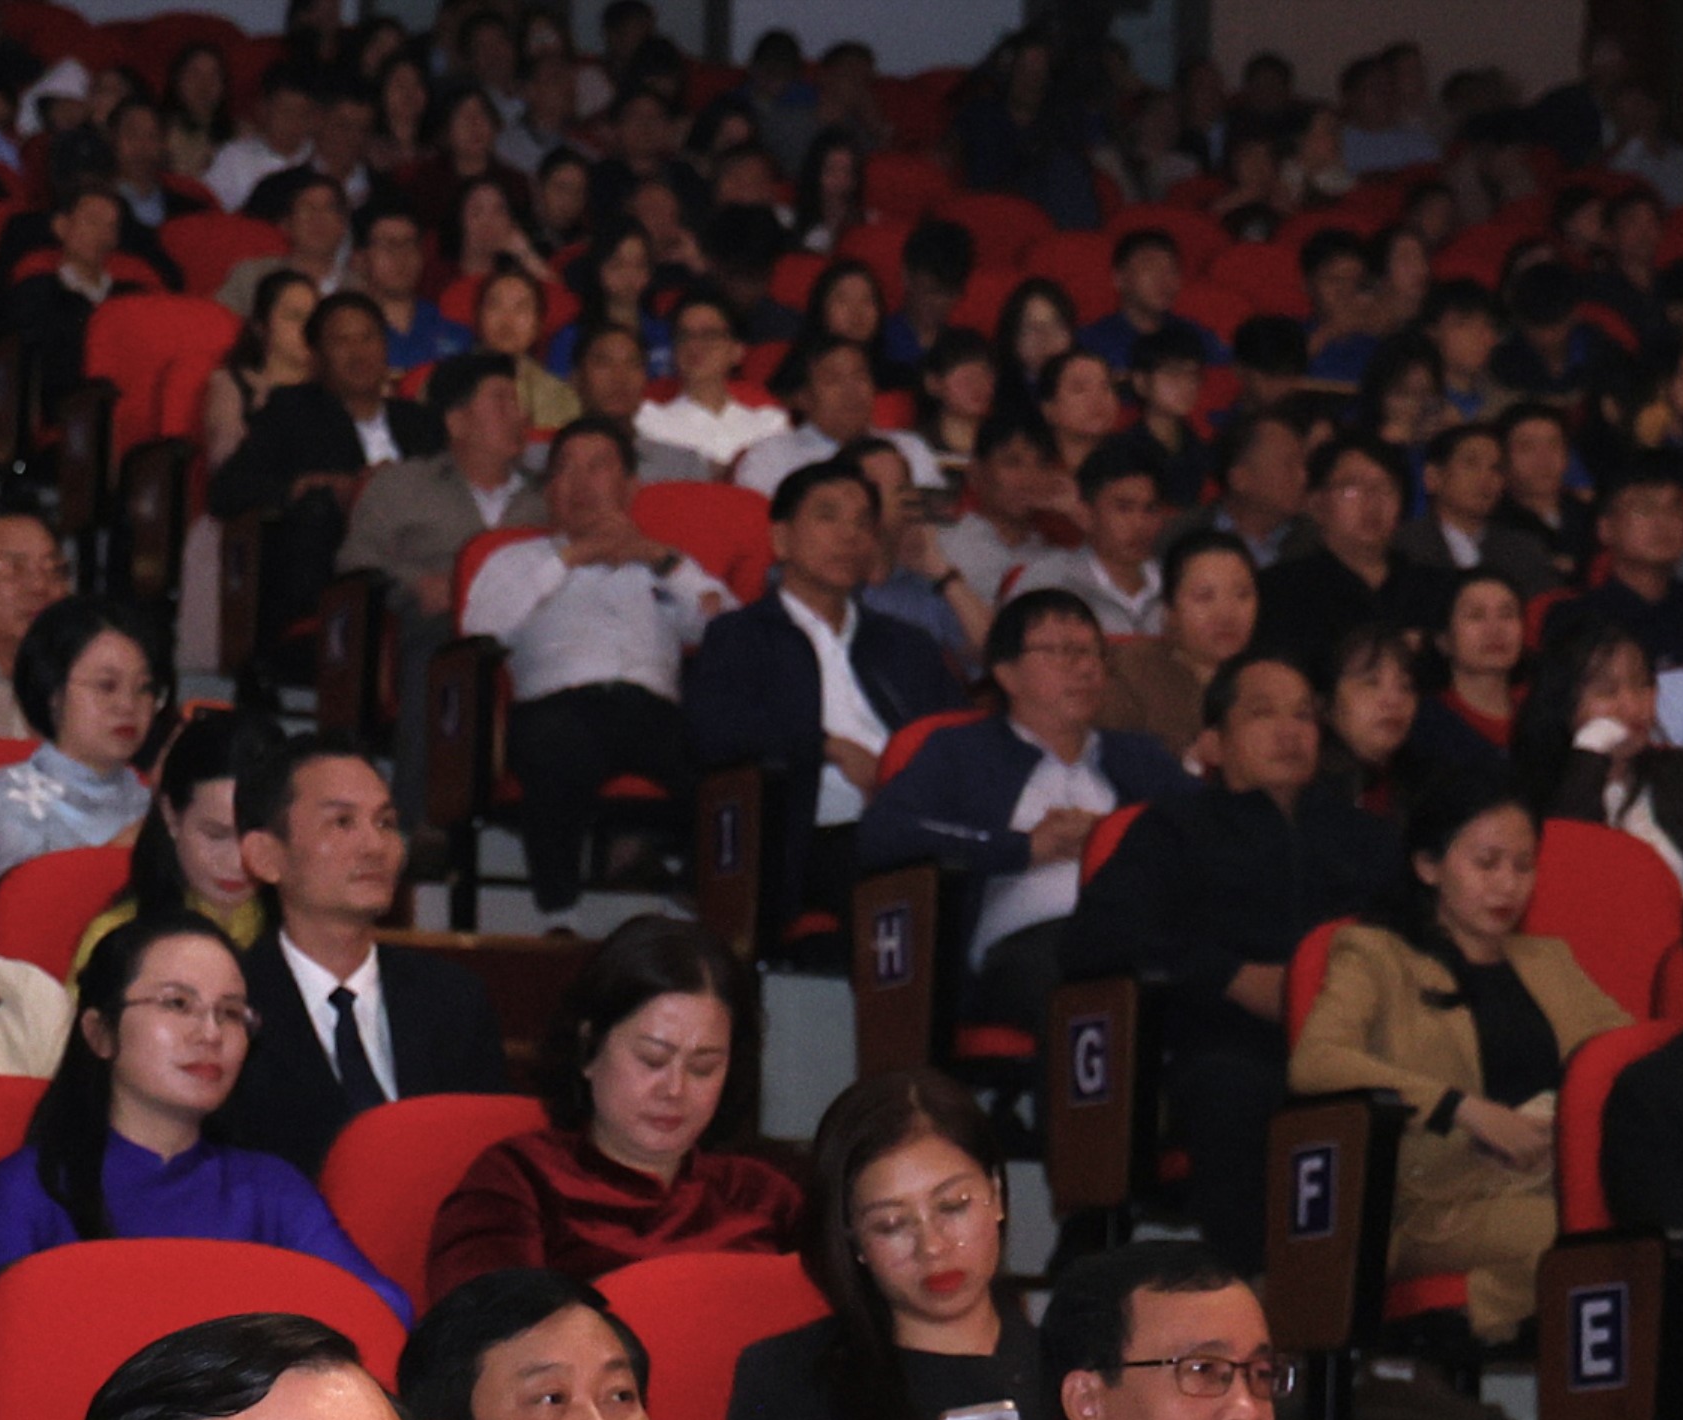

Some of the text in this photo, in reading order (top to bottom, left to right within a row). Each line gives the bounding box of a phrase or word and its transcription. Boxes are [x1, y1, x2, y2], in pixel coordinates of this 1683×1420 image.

[876, 913, 903, 980] H
[1076, 1029, 1104, 1095] G
[1297, 1155, 1324, 1228] F
[1578, 1299, 1613, 1377] E
